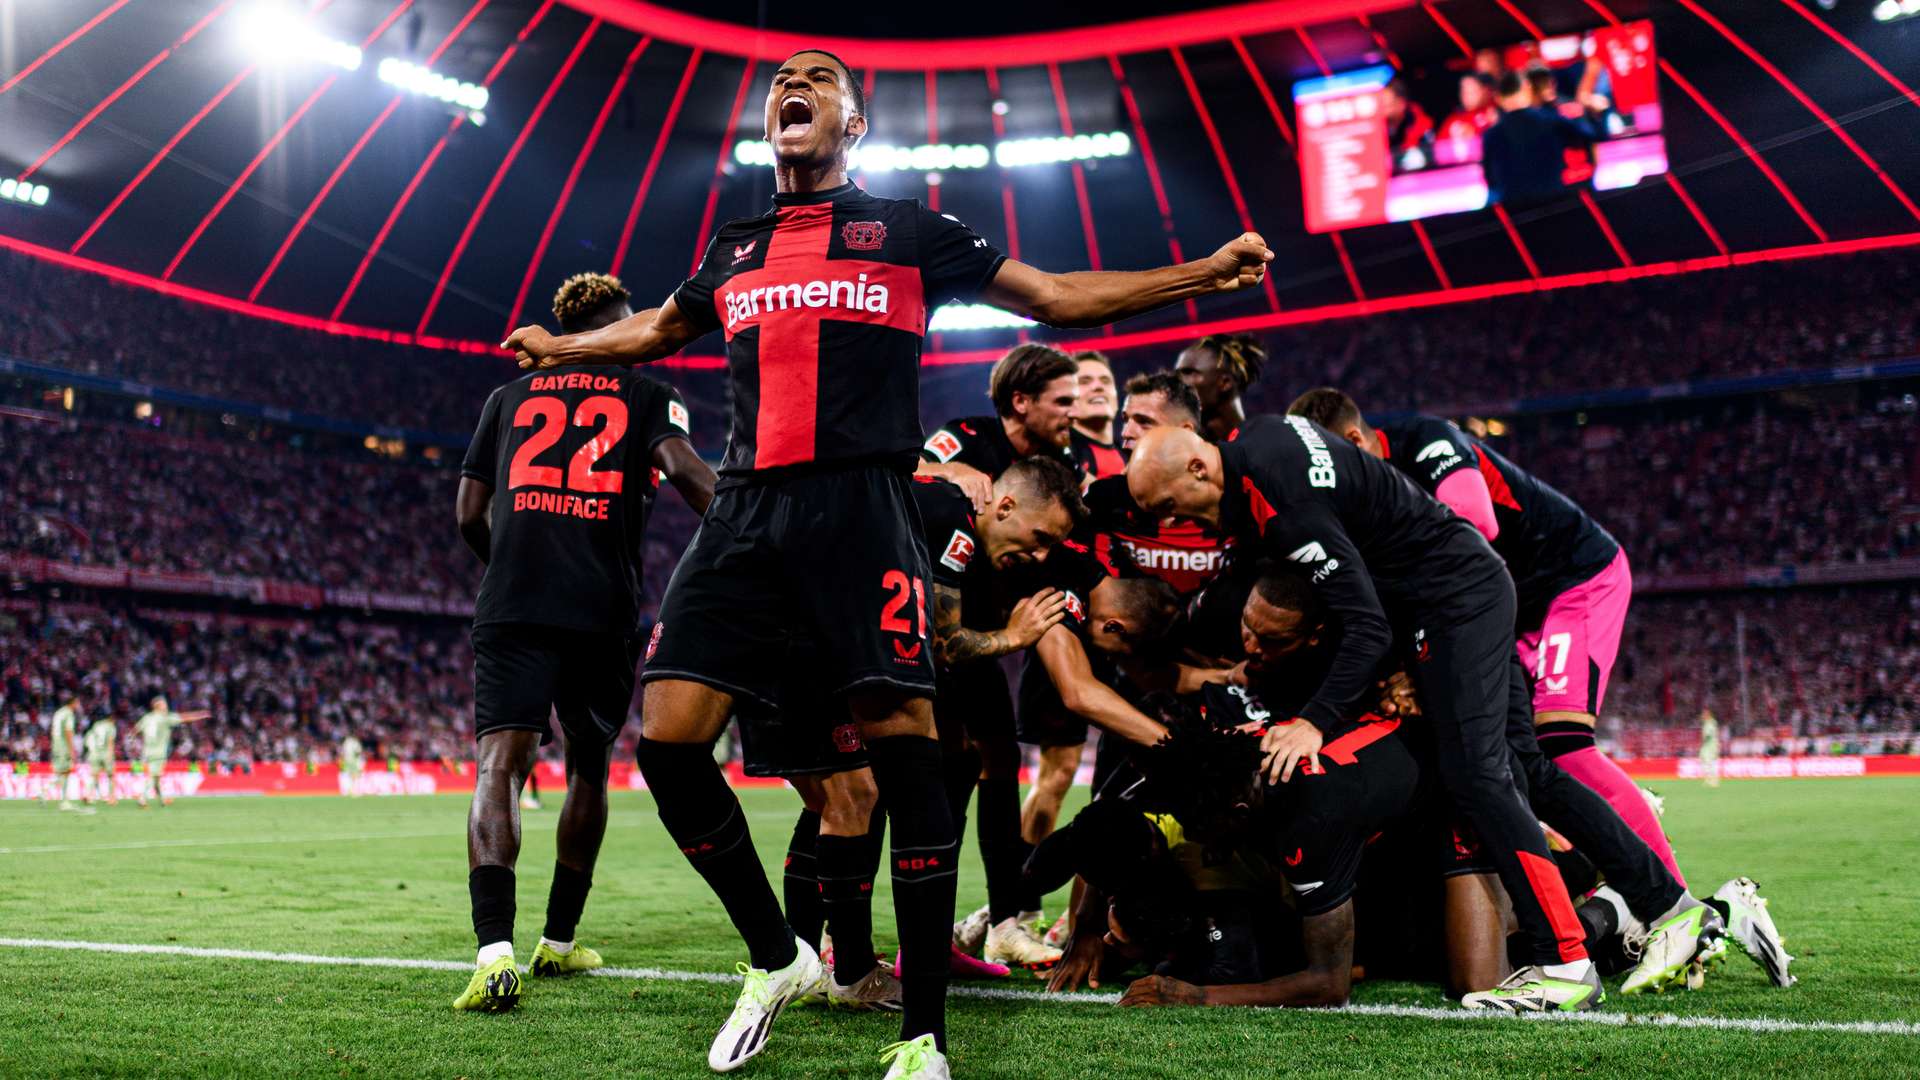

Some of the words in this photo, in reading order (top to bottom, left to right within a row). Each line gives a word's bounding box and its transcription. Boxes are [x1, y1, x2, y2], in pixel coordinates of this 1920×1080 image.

[725, 273, 889, 328] Barmenia
[508, 396, 628, 495] 22
[513, 491, 610, 520] BONIFACE
[1311, 558, 1339, 584] rive
[880, 569, 927, 639] 21
